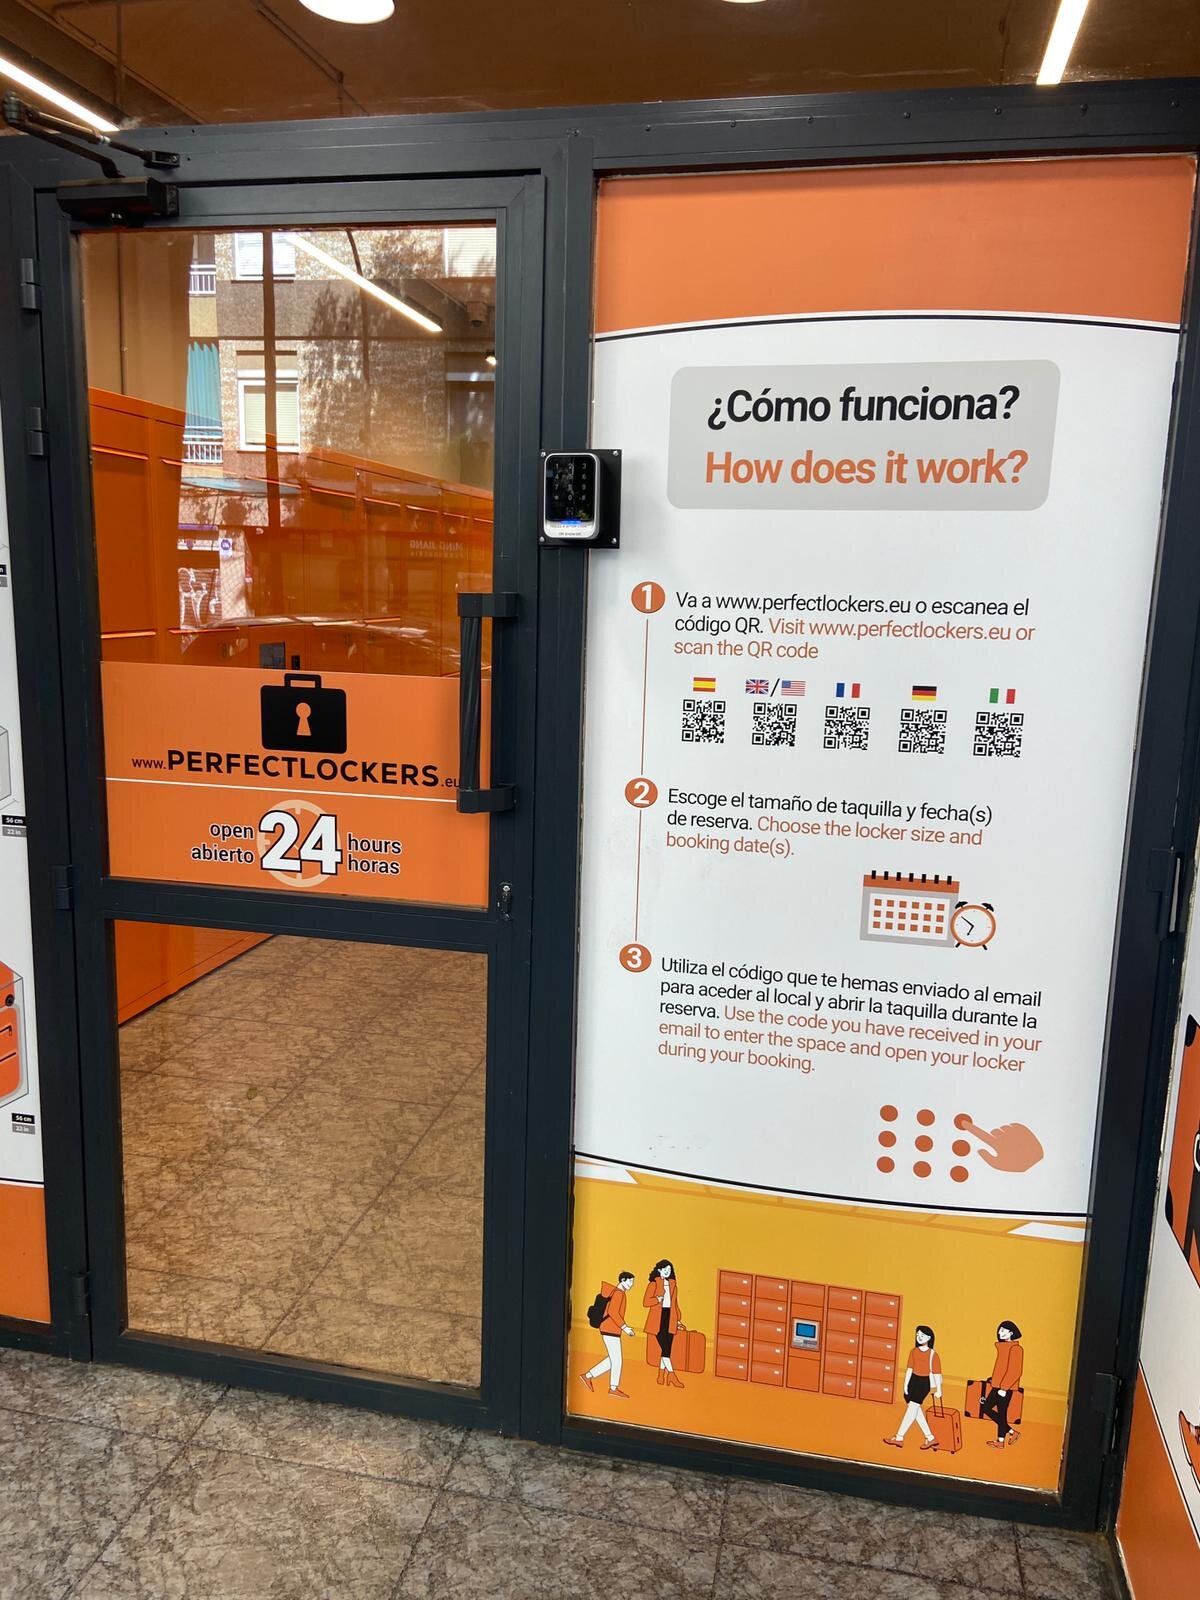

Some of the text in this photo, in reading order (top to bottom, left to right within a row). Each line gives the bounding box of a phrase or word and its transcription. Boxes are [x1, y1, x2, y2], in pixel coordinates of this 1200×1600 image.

[707, 384, 1020, 431] ¿Cómo funciona?
[706, 448, 1029, 484] How does it work?
[641, 584, 652, 610] 1
[676, 591, 1029, 616] Va a www.perfectlockers.eu o escanea el
[675, 614, 1036, 641] código QR. Visit www.perfectlockers.eu or
[674, 639, 819, 659] scan the QR code
[632, 780, 650, 805] 2
[668, 788, 992, 826] Escoge el tamaño de taquilla y fecha(s)
[210, 810, 402, 876] open 24 hours
[666, 831, 794, 859] booking date(s).
[667, 809, 983, 846] de reserva. Choose the locker size and
[191, 844, 400, 874] abierto horas
[626, 947, 642, 970] 3
[661, 957, 1042, 1007] Utiliza el código que te hemas enviado al email
[660, 981, 1037, 1029] para aceder al local y abrir la taquilla durante la
[660, 1002, 1043, 1052] reserva. Use the code you have received in your
[658, 1040, 815, 1074] during your booking.
[659, 1022, 1026, 1072] email to enter the space and open your locker
